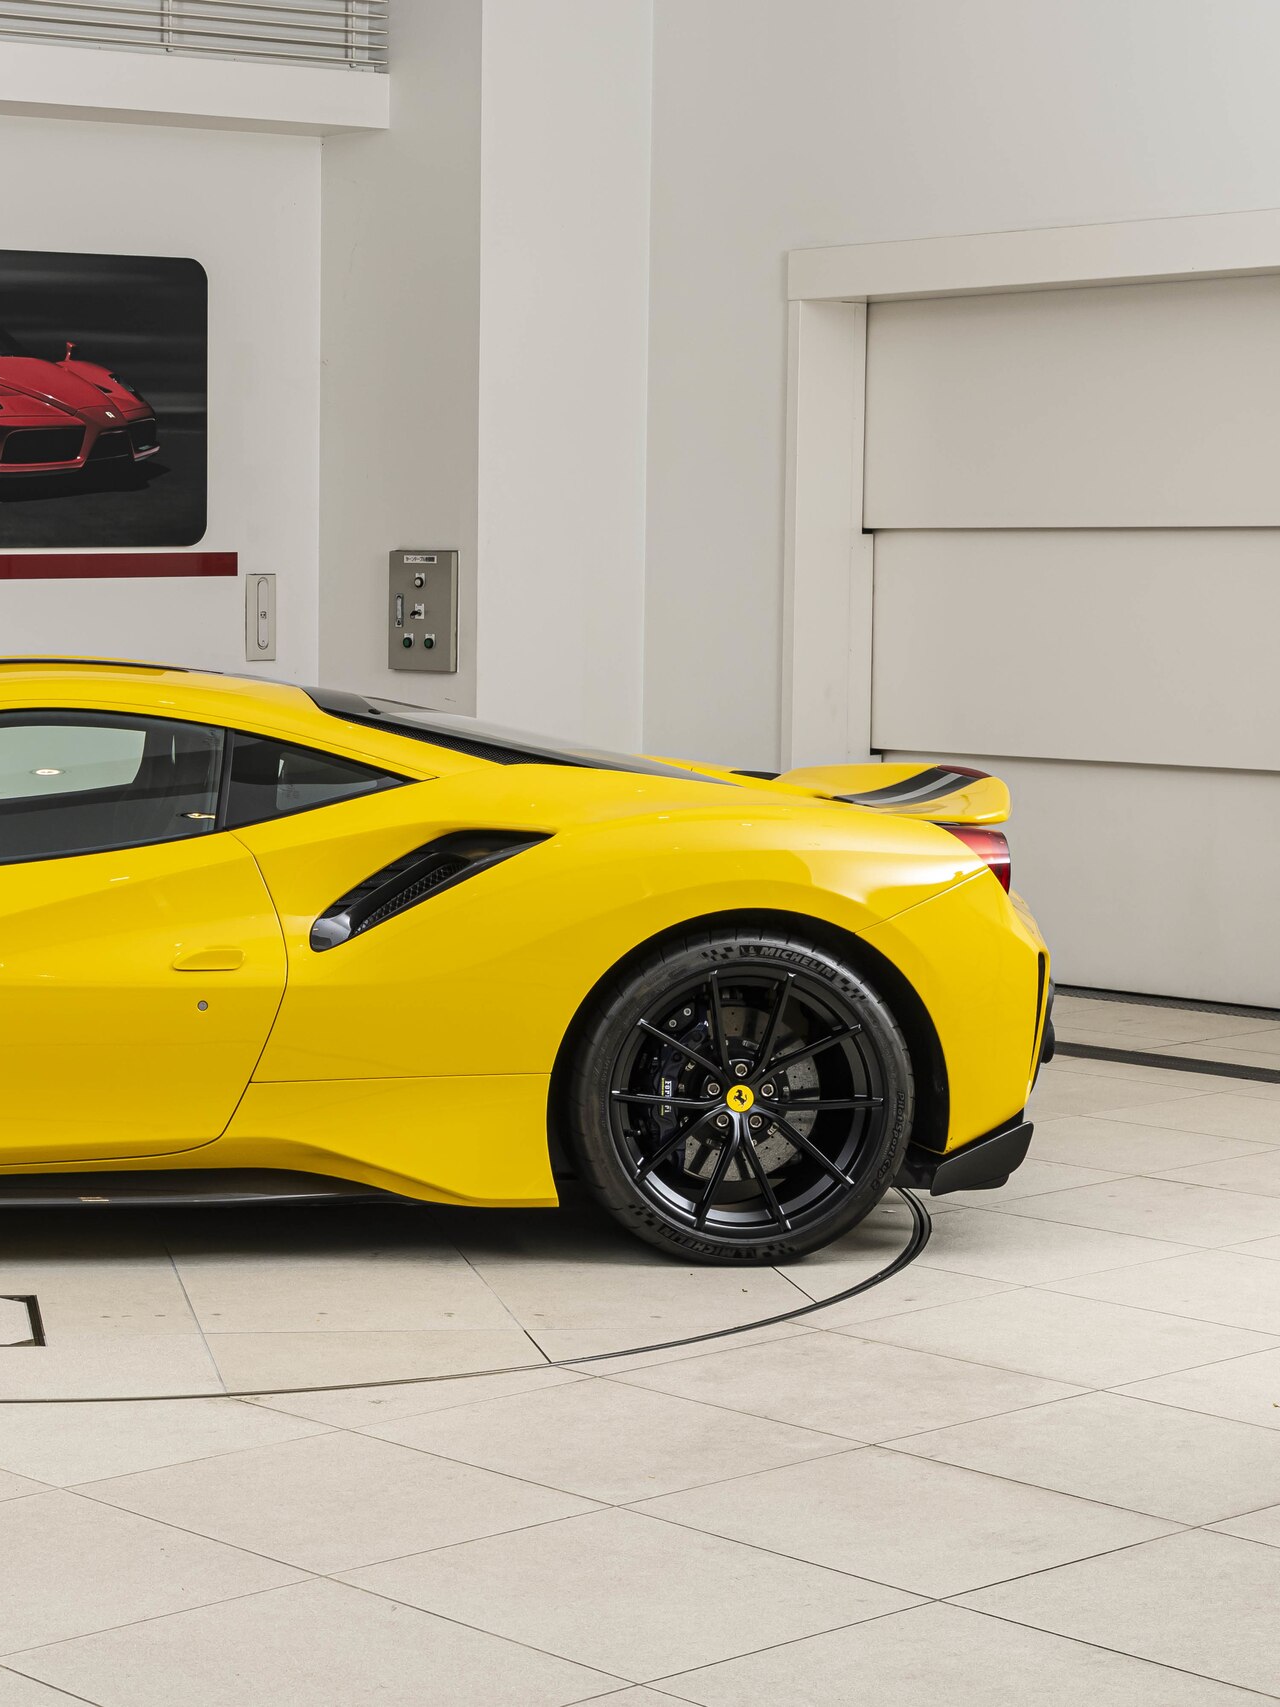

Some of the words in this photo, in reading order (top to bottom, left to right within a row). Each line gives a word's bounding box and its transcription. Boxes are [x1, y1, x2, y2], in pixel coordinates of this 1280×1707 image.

[760, 946, 836, 978] MICHELIN
[896, 1091, 905, 1122] Pilot
[888, 1122, 903, 1157] Sport
[878, 1159, 891, 1179] Cup
[660, 1224, 734, 1257] MICHELIN
